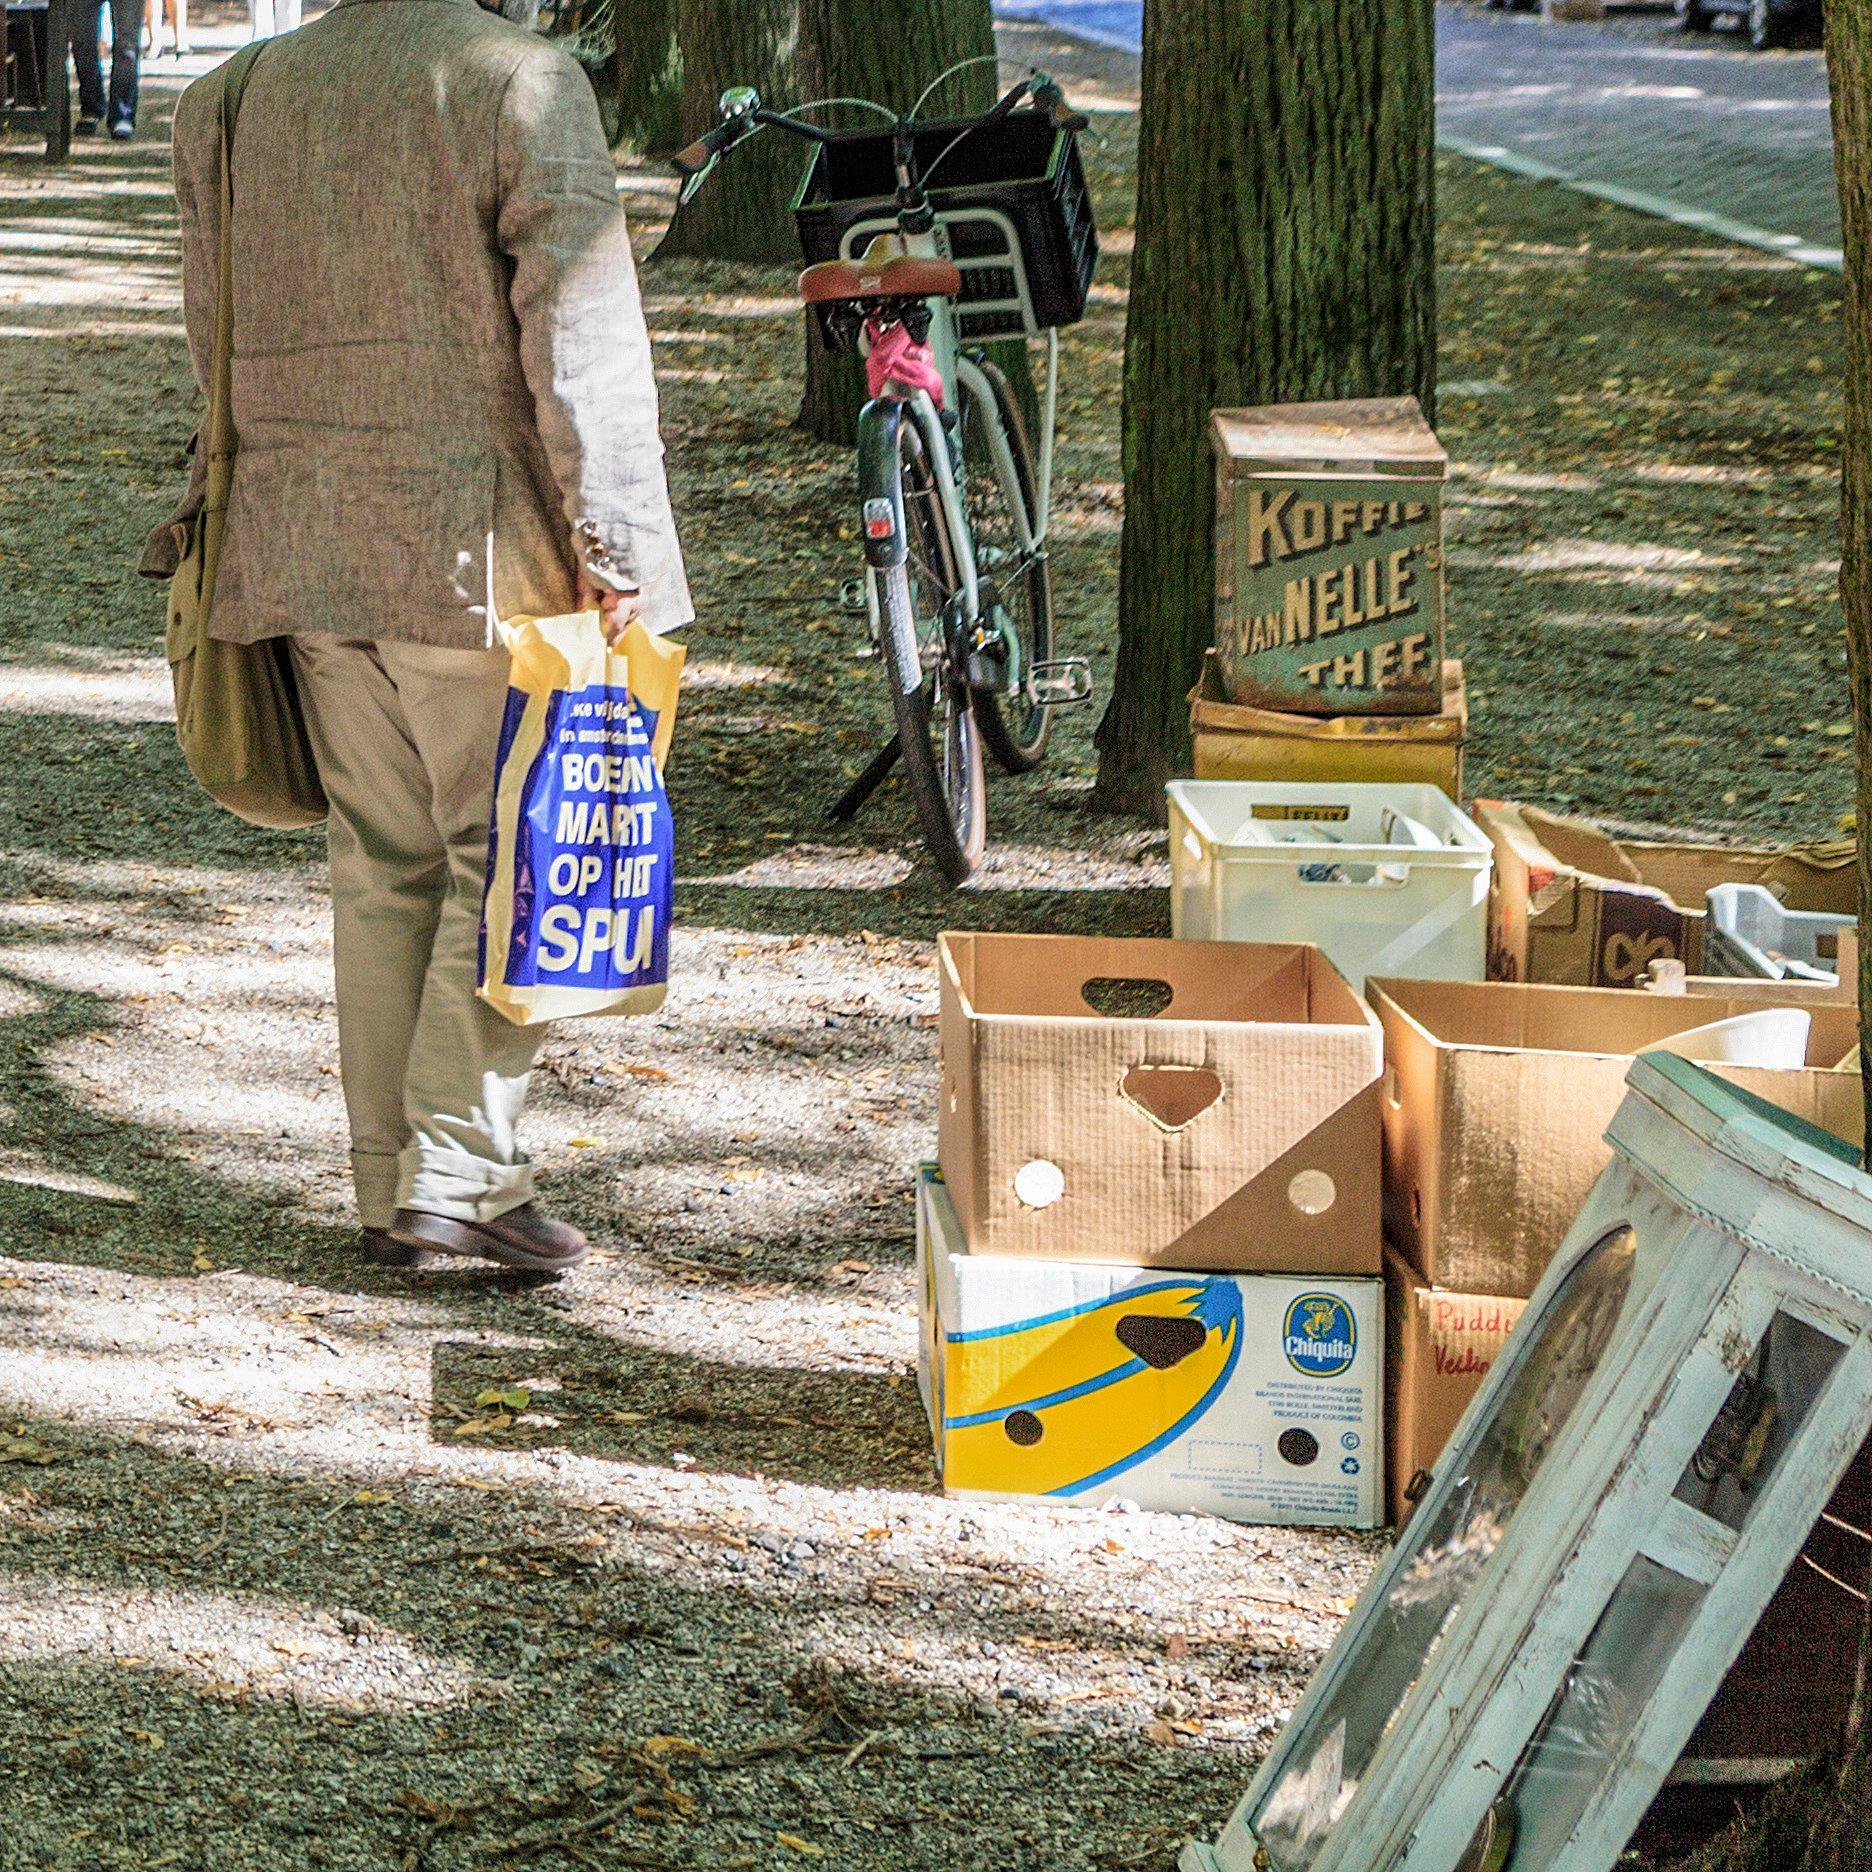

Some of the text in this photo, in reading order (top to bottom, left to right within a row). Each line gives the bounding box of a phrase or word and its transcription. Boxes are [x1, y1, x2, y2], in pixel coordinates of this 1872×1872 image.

[1247, 486, 1430, 569] KOFFIE
[1239, 611, 1282, 657] VAN
[548, 853, 603, 897] OP
[537, 903, 655, 975] SPUI
[1285, 1336, 1354, 1363] Chiquita
